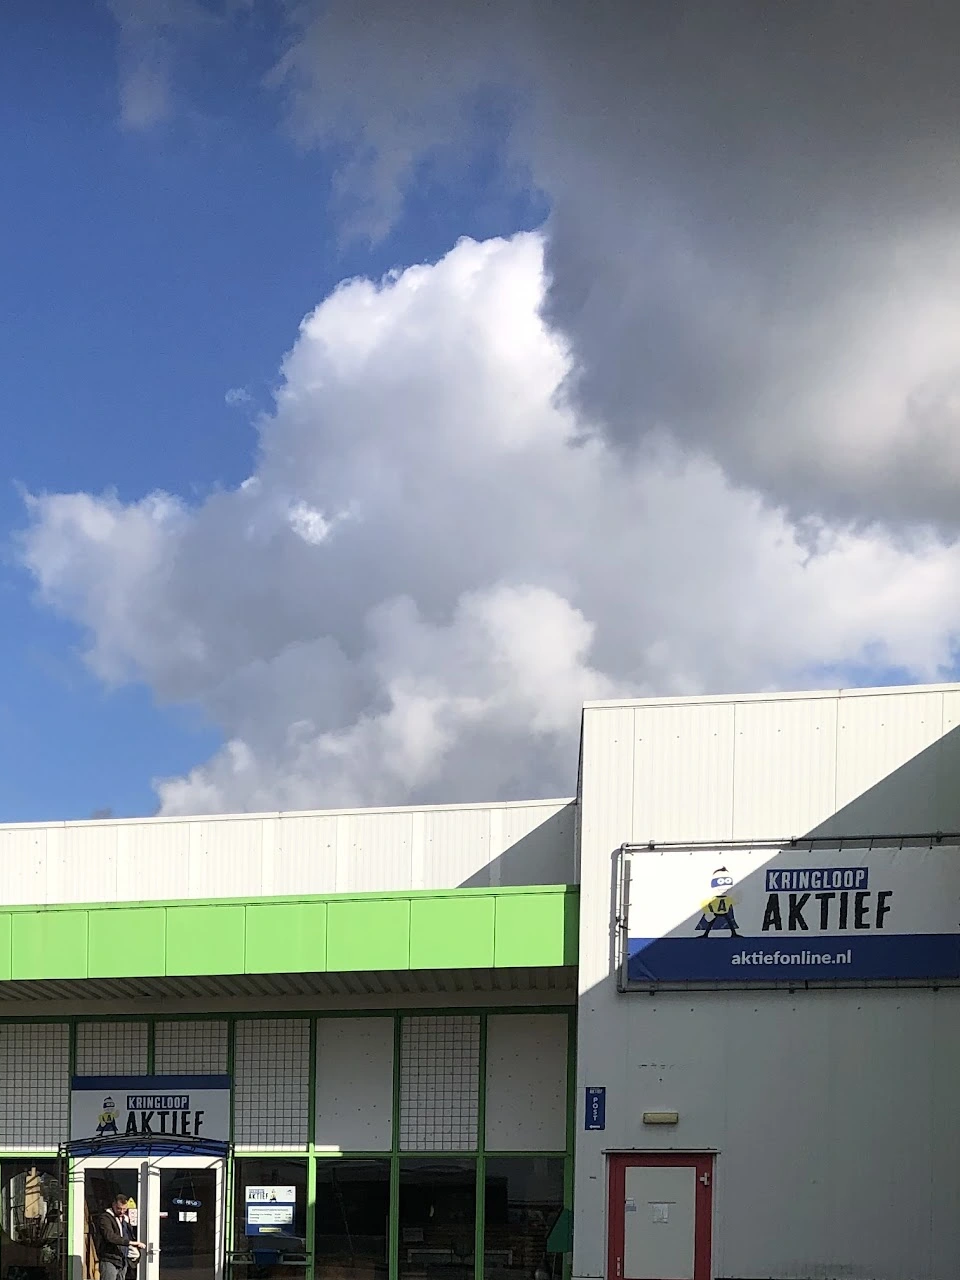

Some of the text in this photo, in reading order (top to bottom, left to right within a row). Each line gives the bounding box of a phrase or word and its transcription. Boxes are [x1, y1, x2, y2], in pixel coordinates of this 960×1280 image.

[769, 870, 865, 889] KRINGLOOP
[762, 891, 893, 931] AKTIEF
[731, 949, 852, 966] aktiefonline.nl
[128, 1096, 187, 1109] KRINGLOOP
[126, 1111, 205, 1135] AKTIEF
